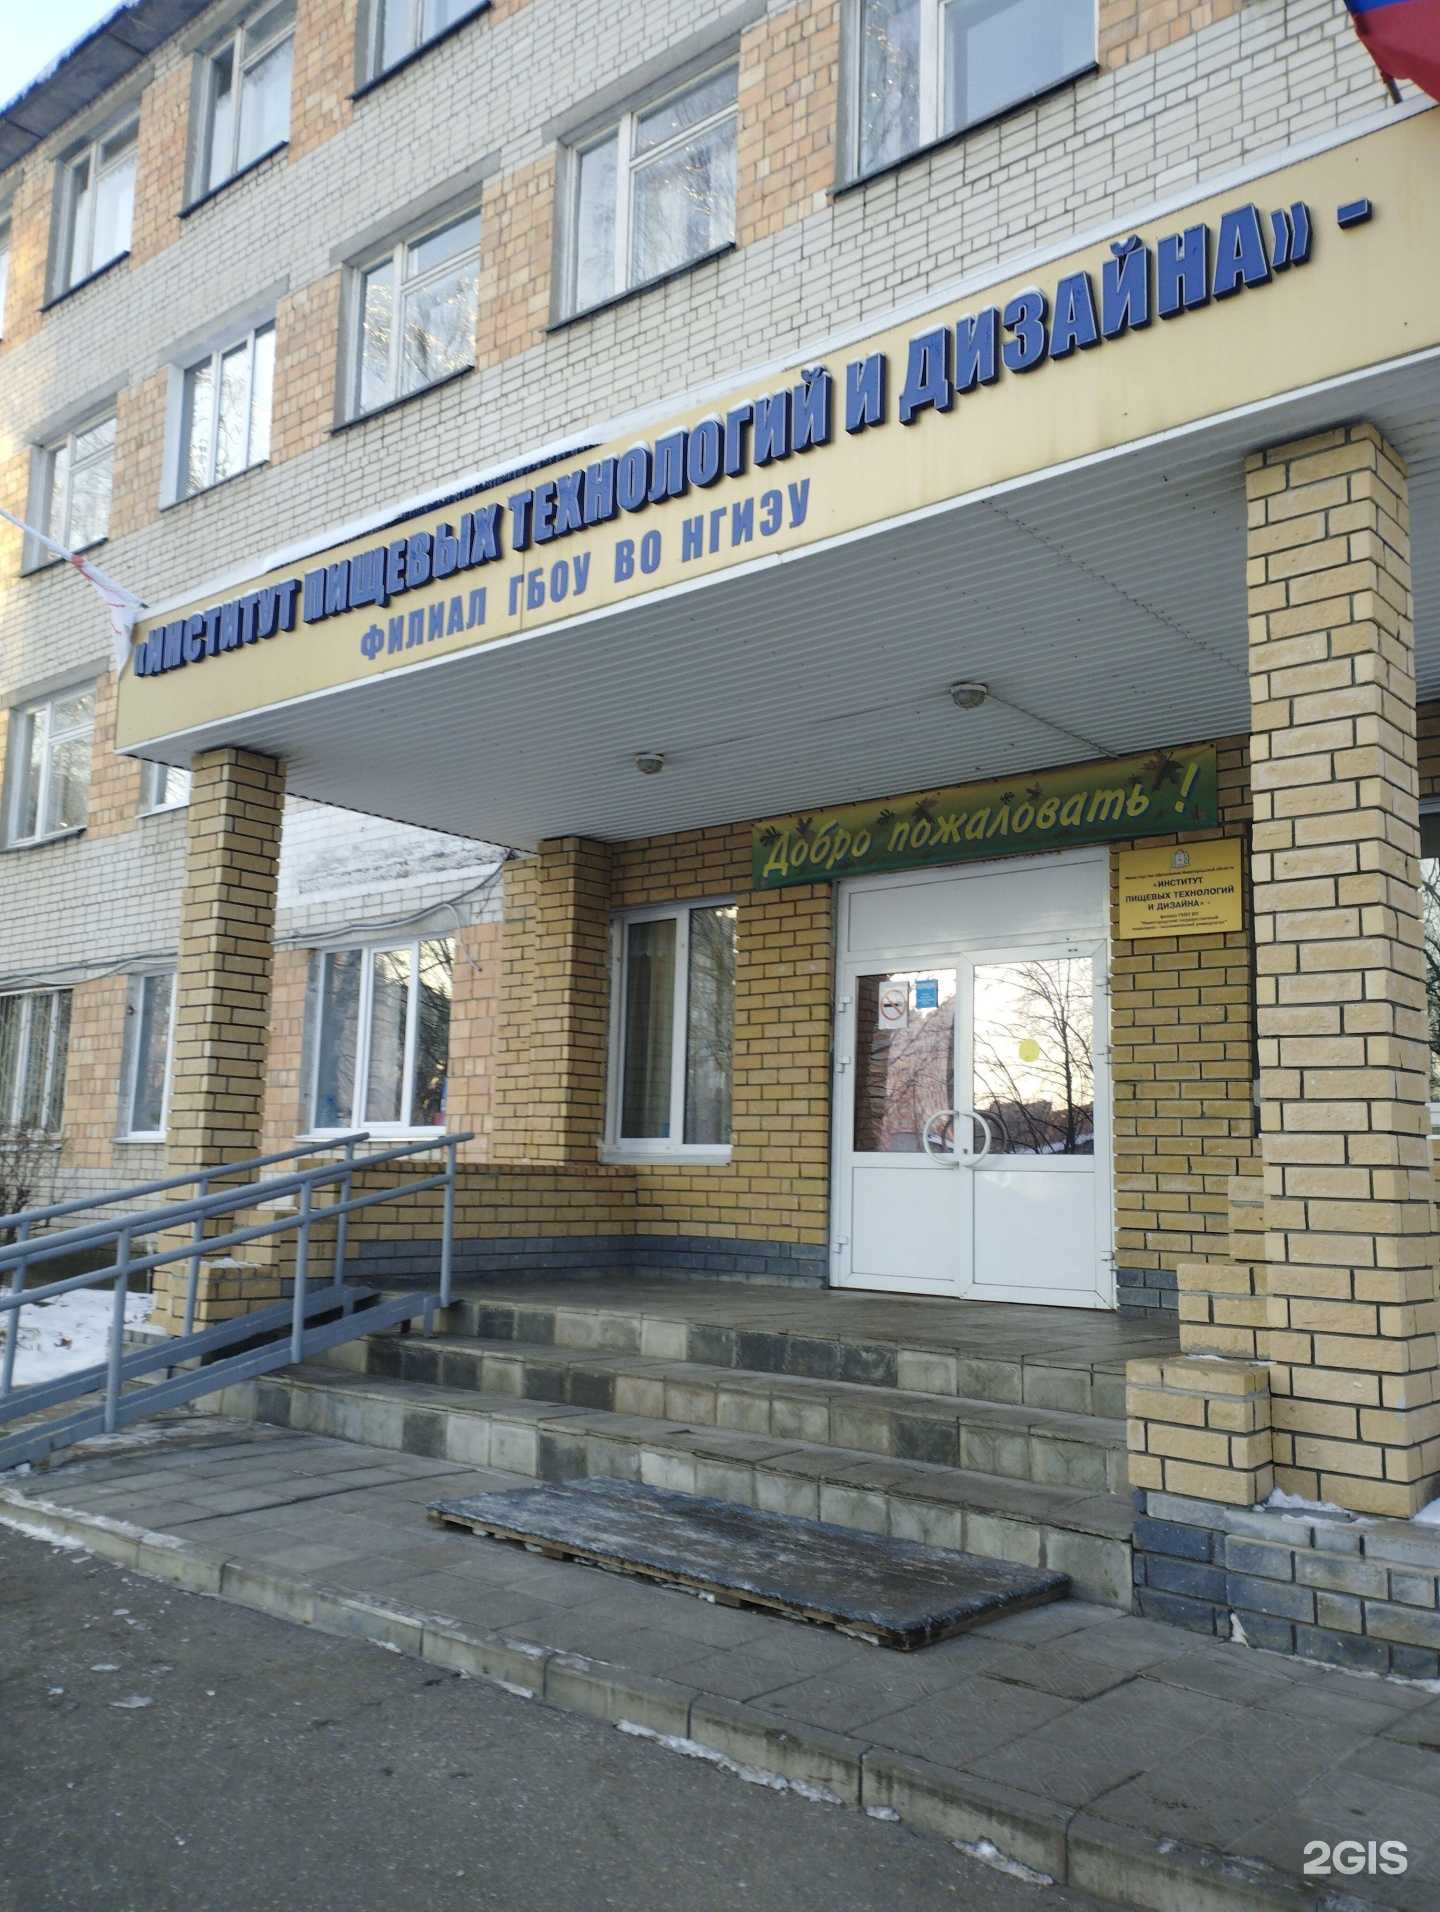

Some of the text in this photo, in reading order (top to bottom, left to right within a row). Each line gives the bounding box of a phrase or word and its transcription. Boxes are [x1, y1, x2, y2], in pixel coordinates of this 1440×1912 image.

[302, 503, 503, 624] ПИЩЕВЫХ
[507, 366, 833, 551] ТЕХНОЛОГИЙ
[845, 351, 886, 434] И
[898, 200, 1314, 425] ДИЗАЙНА»
[360, 477, 811, 661] ФИЛИАЛ ГБОУ ВО НГИЭУ
[763, 819, 872, 878] Добро
[888, 784, 1149, 852] пожаловать
[1125, 886, 1235, 903] ПИЩЕВЫХ ТЕХНОЛОГИЙ
[1148, 903, 1155, 911] И
